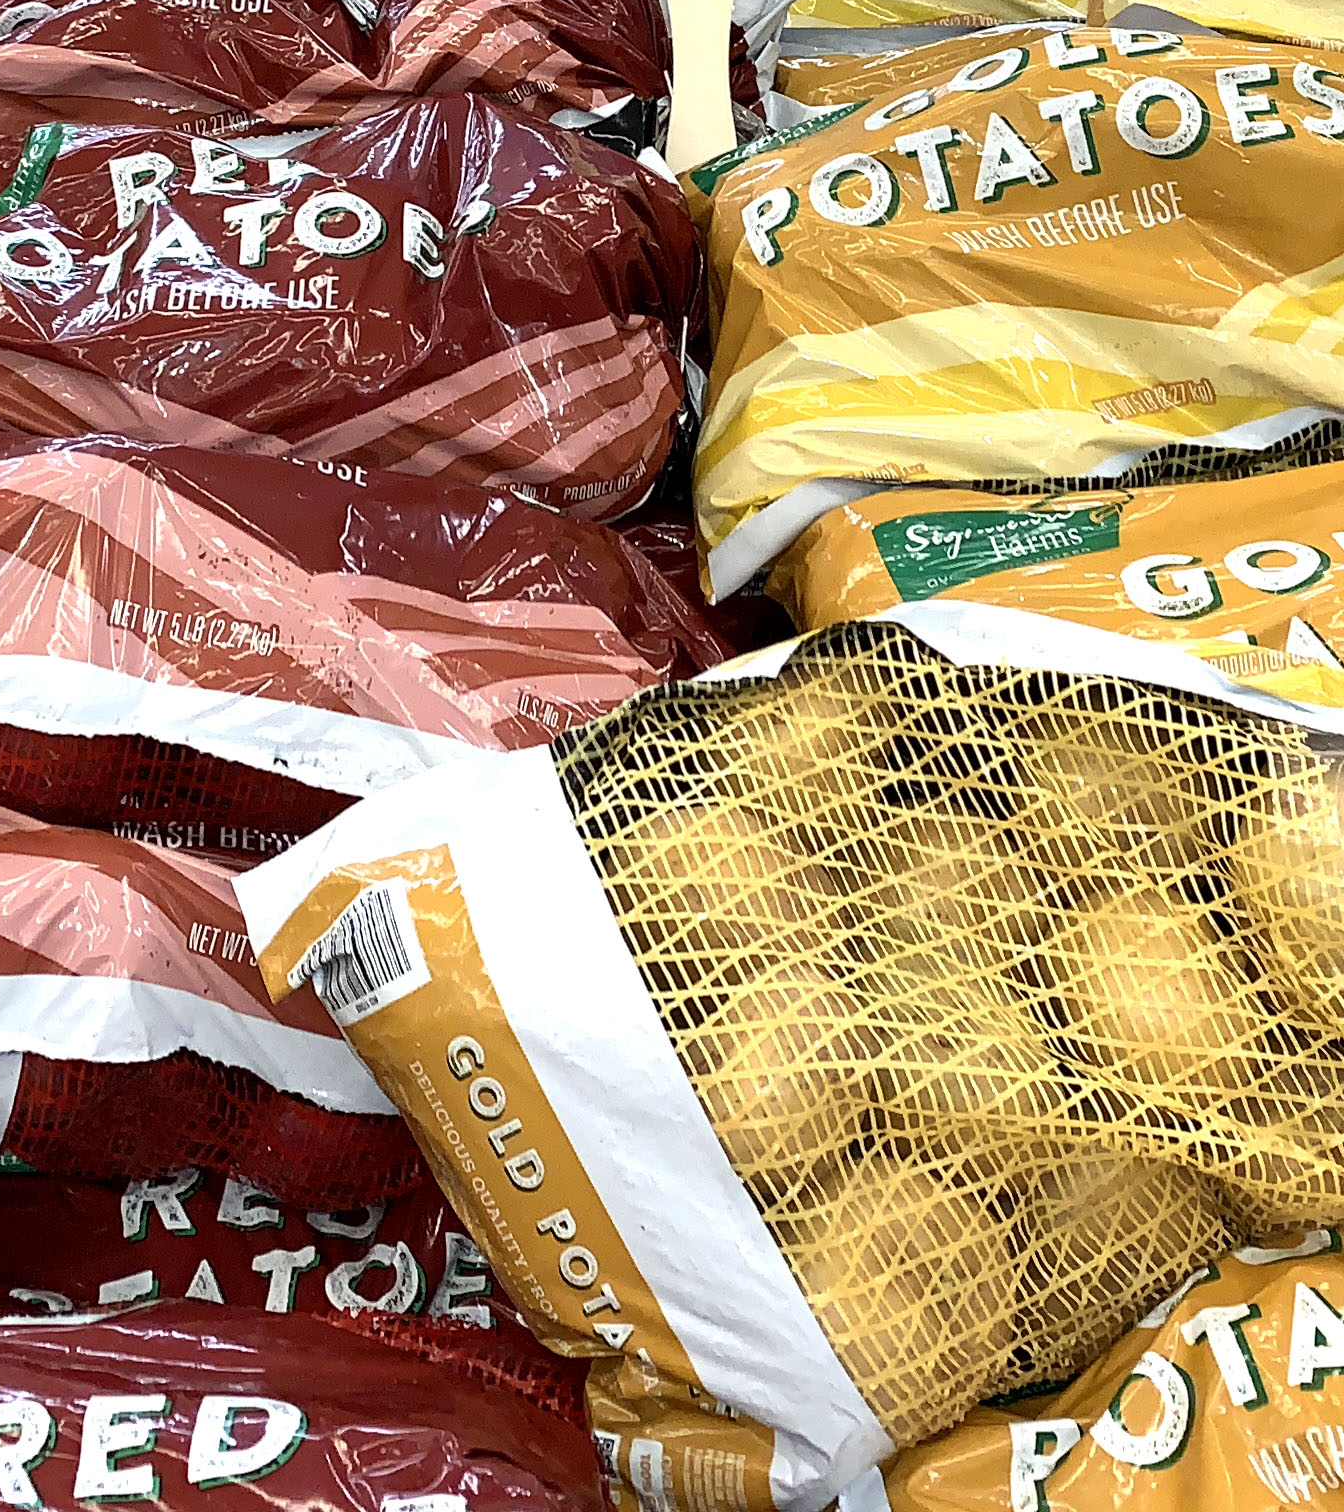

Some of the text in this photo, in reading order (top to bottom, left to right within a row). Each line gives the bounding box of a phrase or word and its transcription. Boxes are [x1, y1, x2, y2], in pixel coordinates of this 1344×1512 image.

[944, 179, 1187, 255] WASH BEFORE USE
[167, 281, 276, 312] BEFORE
[286, 274, 340, 312] USE
[1190, 379, 1215, 403] kg)
[562, 472, 634, 501] PRODUCT OF
[991, 521, 1084, 563] Farms
[111, 598, 279, 658] NET WT 5 LB (2.27 kg)
[112, 821, 208, 850] WASH
[188, 922, 249, 964] NET WT
[445, 1034, 548, 1193] GOLD
[407, 1058, 529, 1270] DELICIOUS QUALITY
